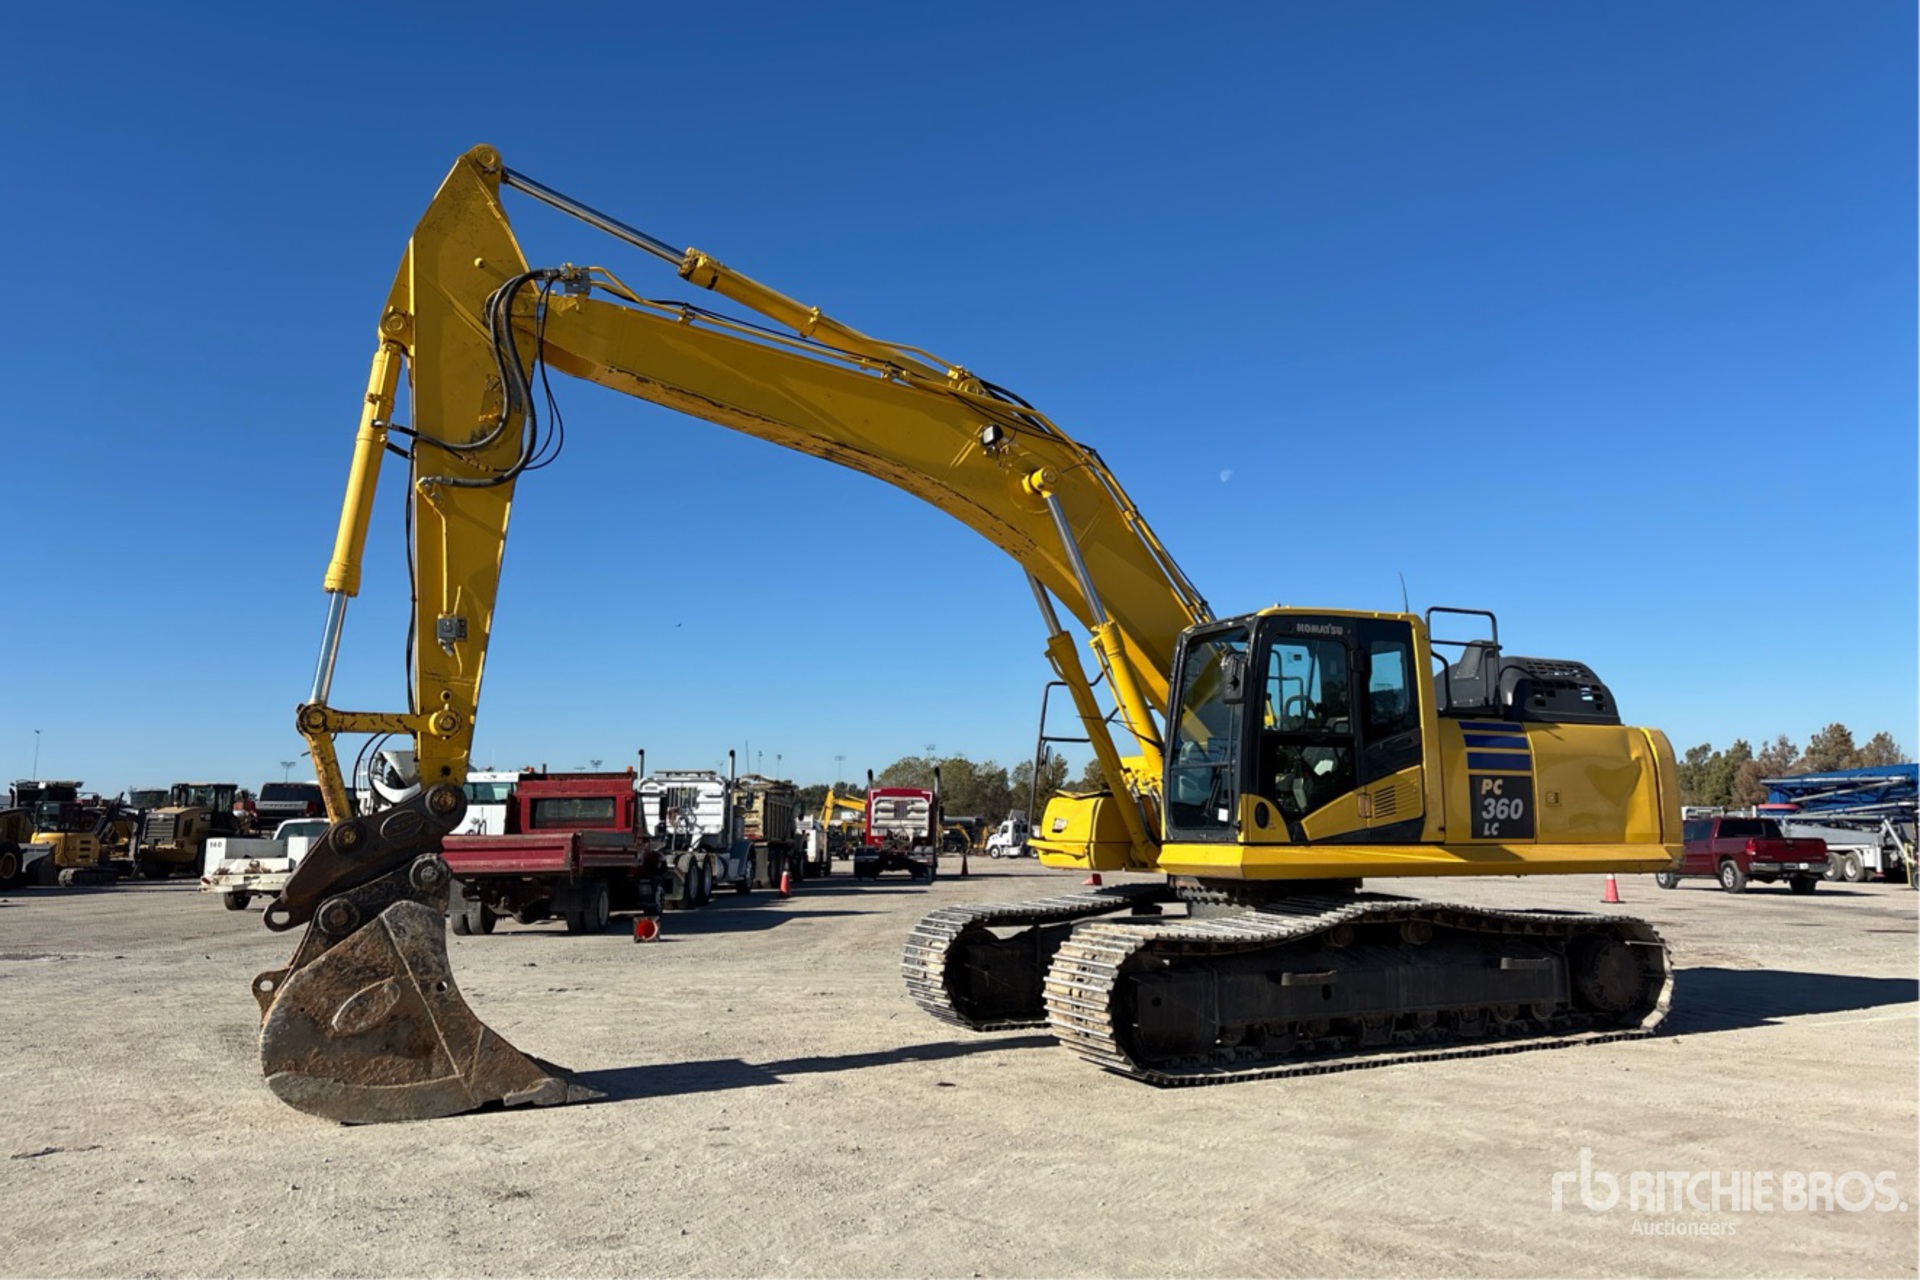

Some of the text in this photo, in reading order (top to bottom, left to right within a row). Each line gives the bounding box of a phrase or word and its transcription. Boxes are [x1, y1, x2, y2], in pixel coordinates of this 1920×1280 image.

[1297, 624, 1343, 635] KOMATSU
[1481, 779, 1503, 795] PC
[1482, 798, 1523, 820] 360
[1484, 822, 1500, 836] LC
